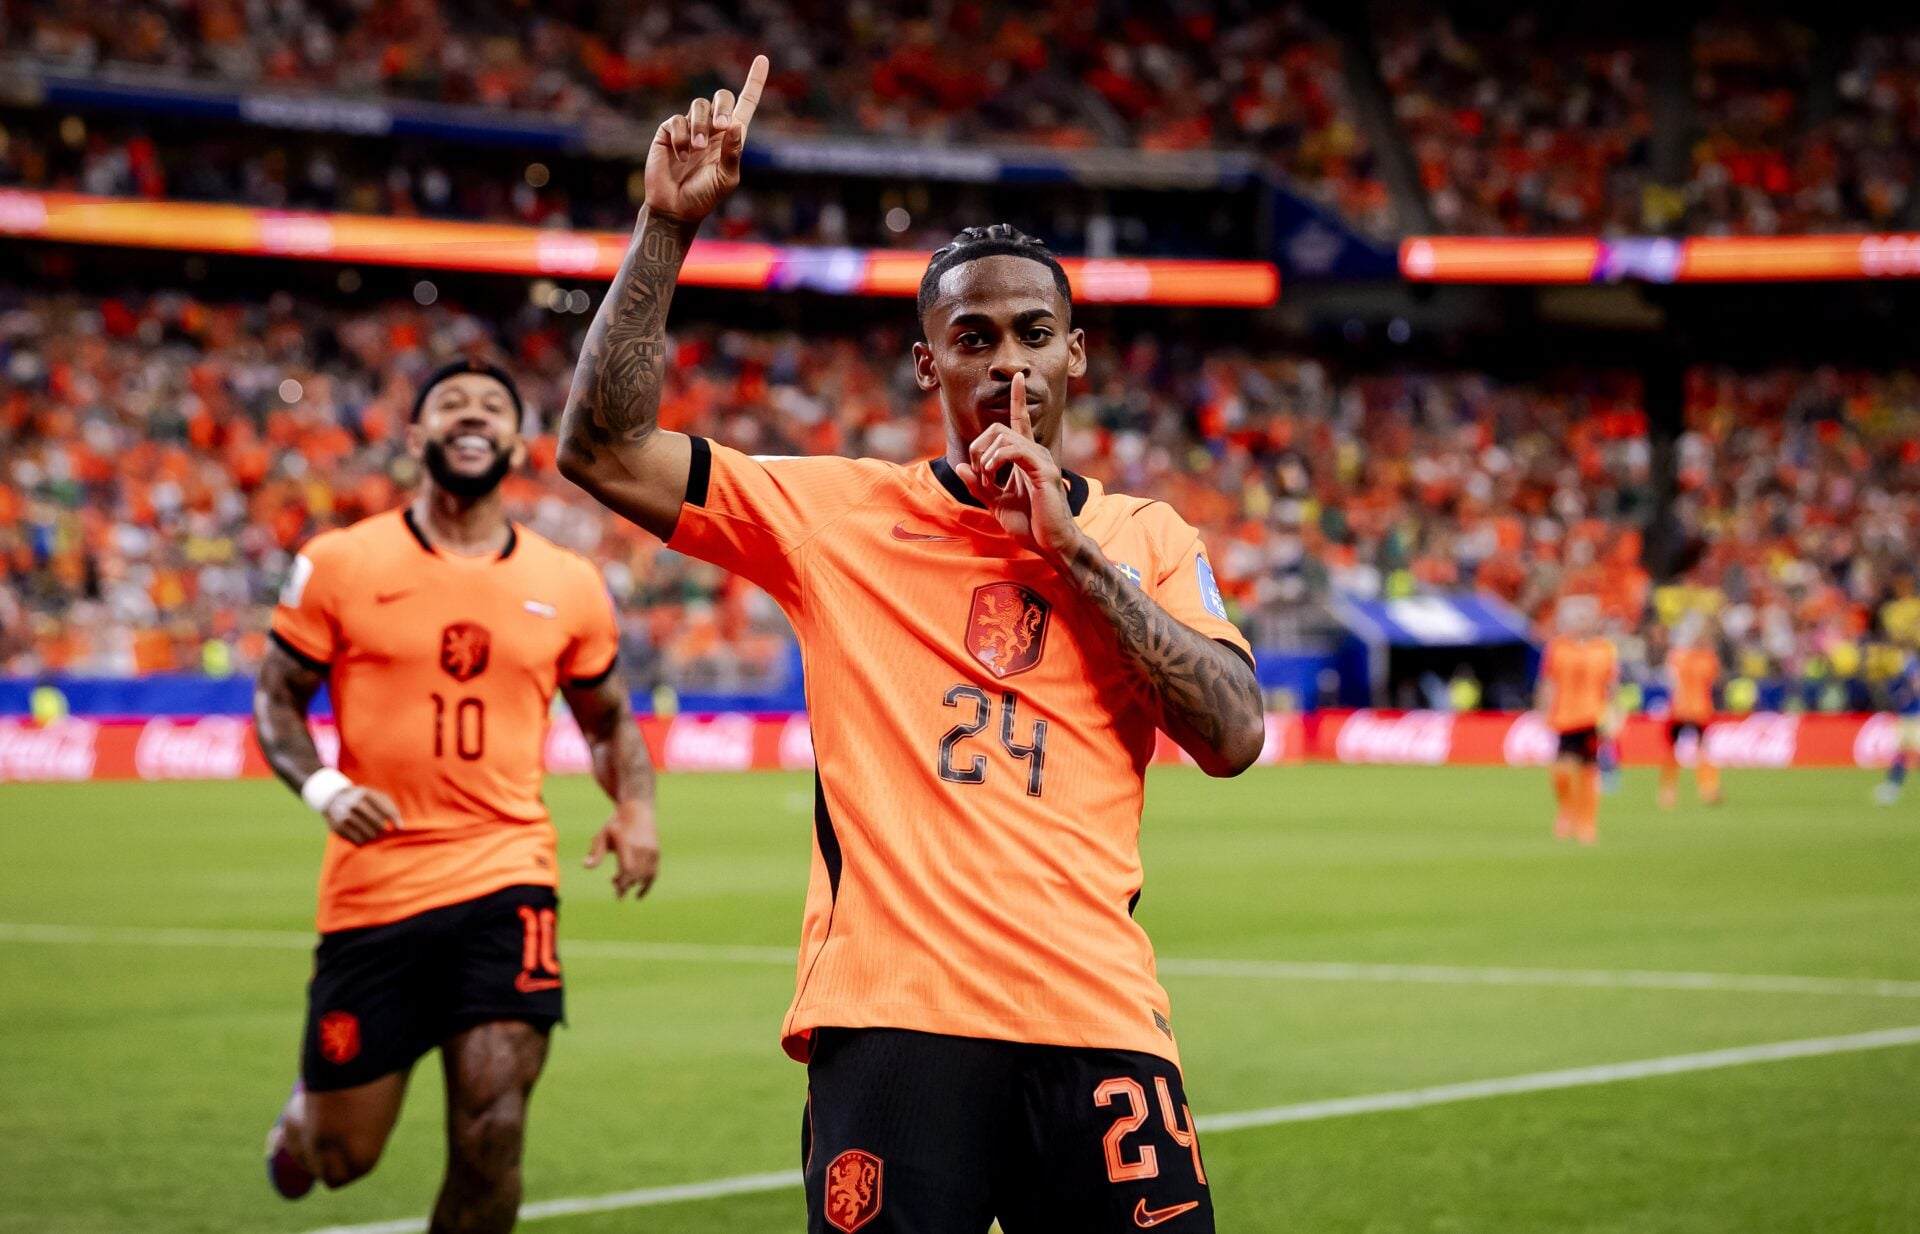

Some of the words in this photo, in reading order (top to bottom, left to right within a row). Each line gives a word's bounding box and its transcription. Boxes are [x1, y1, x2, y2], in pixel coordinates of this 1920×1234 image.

[430, 693, 484, 761] 10
[938, 683, 1048, 797] 24
[1093, 1076, 1207, 1185] 24
